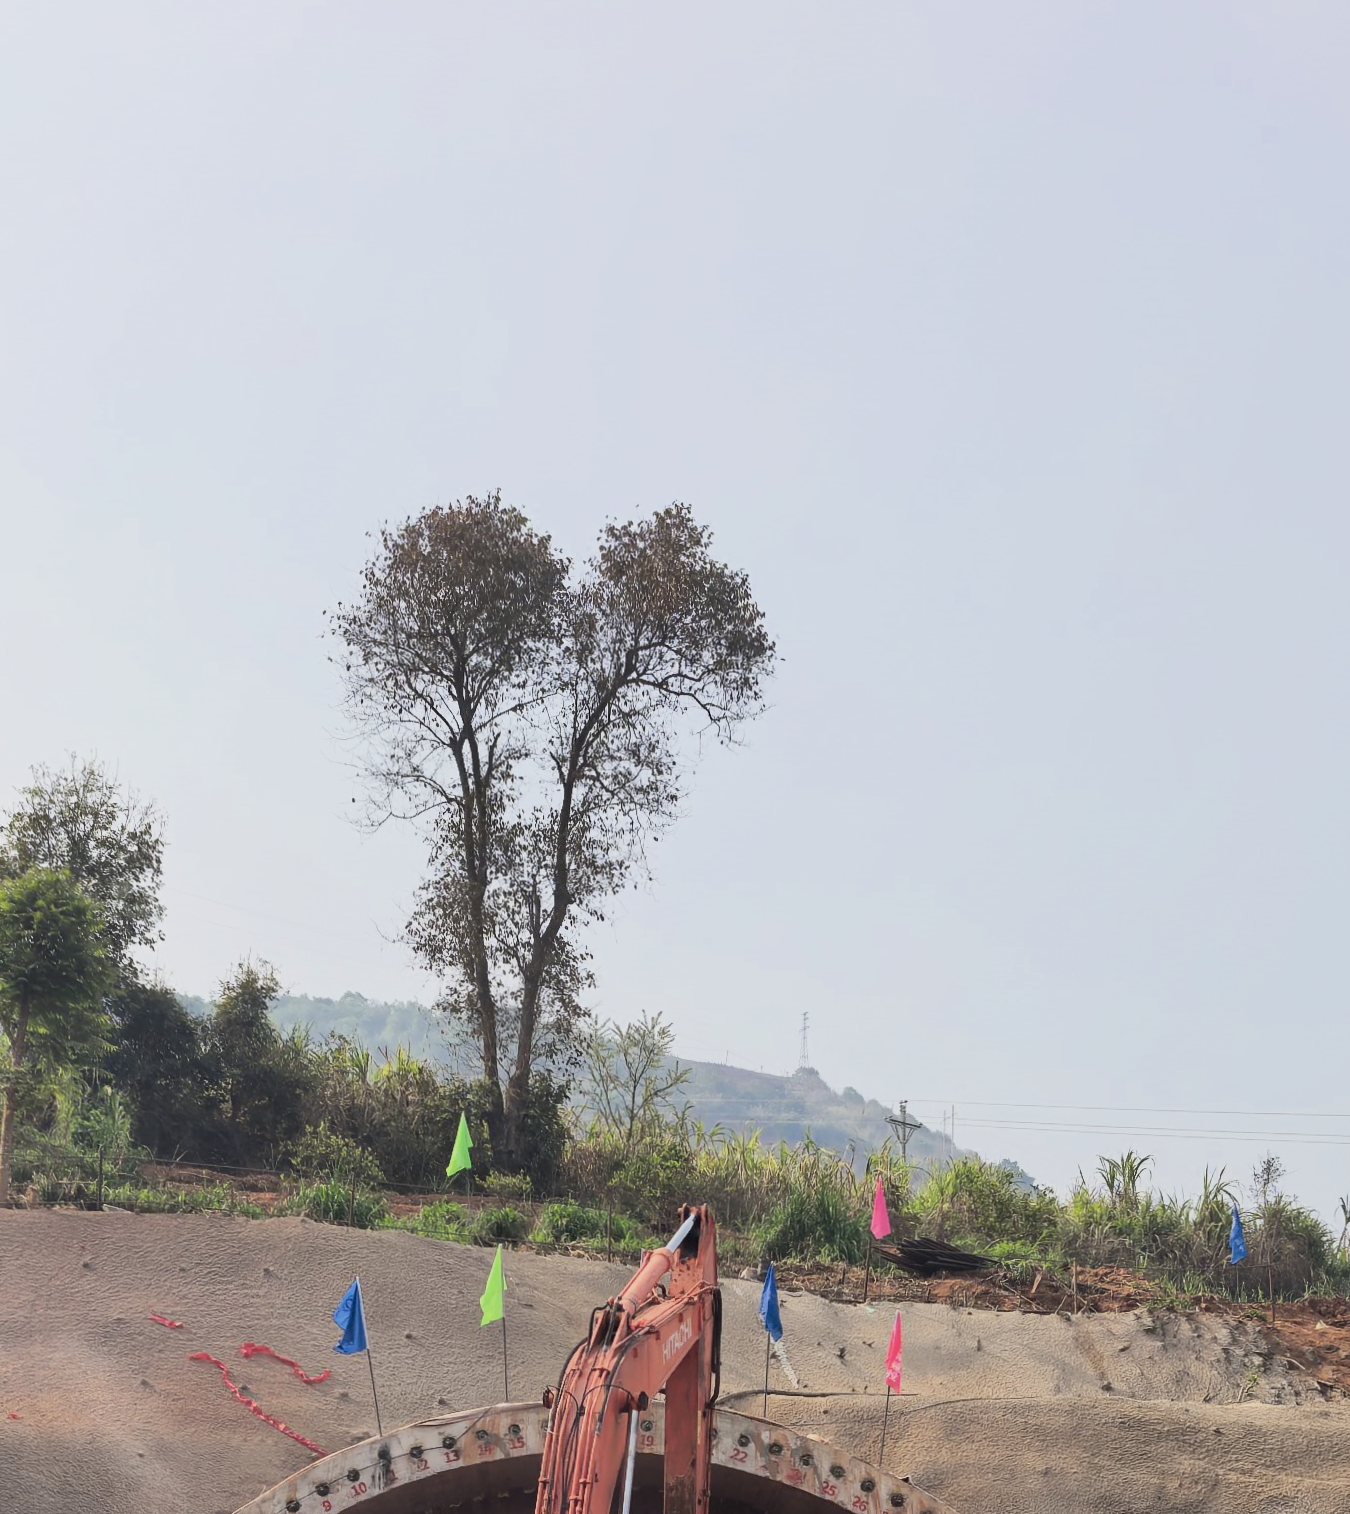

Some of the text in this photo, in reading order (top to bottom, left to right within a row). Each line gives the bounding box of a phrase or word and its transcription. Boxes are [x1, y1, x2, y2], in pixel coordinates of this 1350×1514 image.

[662, 1317, 693, 1364] HITACHI
[508, 1437, 526, 1450] 15
[639, 1434, 655, 1447] 19
[443, 1449, 461, 1463] 13
[729, 1447, 748, 1463] 22
[350, 1481, 369, 1497] 10
[822, 1480, 838, 1497] 25
[322, 1500, 333, 1512] 9
[851, 1495, 869, 1512] 26
